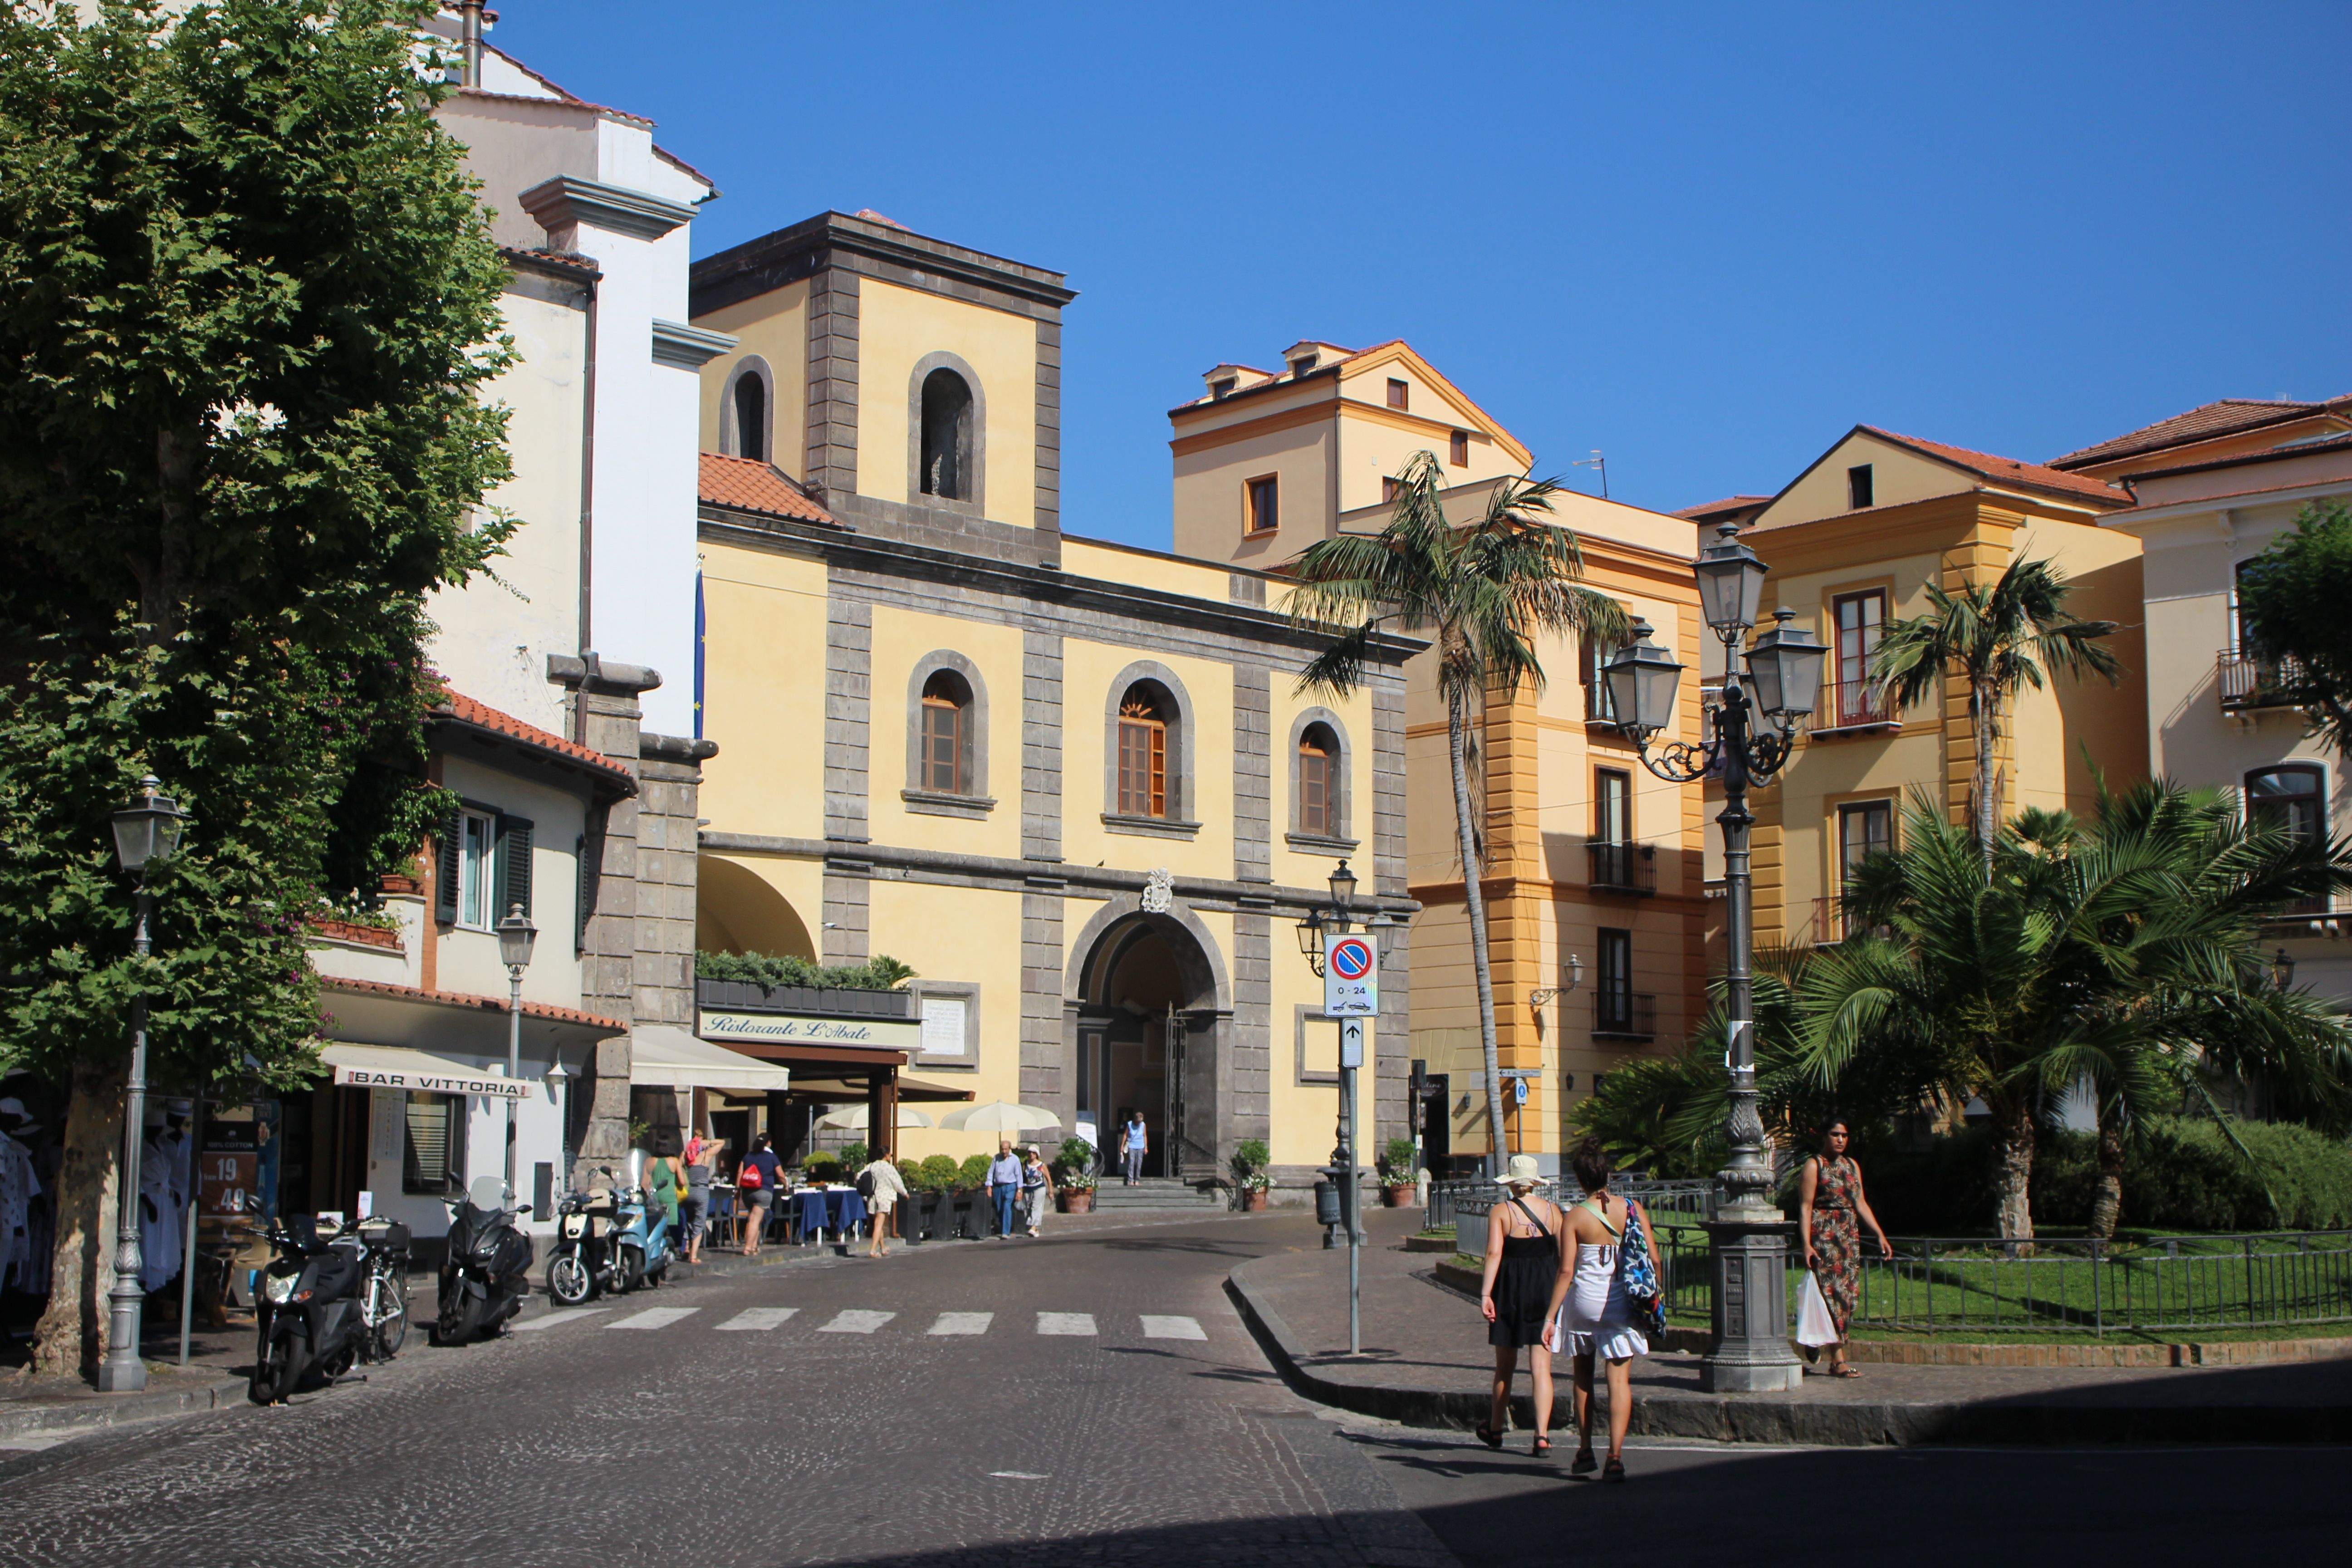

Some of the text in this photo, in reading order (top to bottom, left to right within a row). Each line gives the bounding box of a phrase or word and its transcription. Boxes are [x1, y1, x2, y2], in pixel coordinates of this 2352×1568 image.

[705, 1015, 871, 1039] Ristorante L'Abate
[354, 1072, 518, 1094] BAR VITTORIA
[217, 1158, 237, 1181] 19
[220, 1188, 245, 1211] 49
